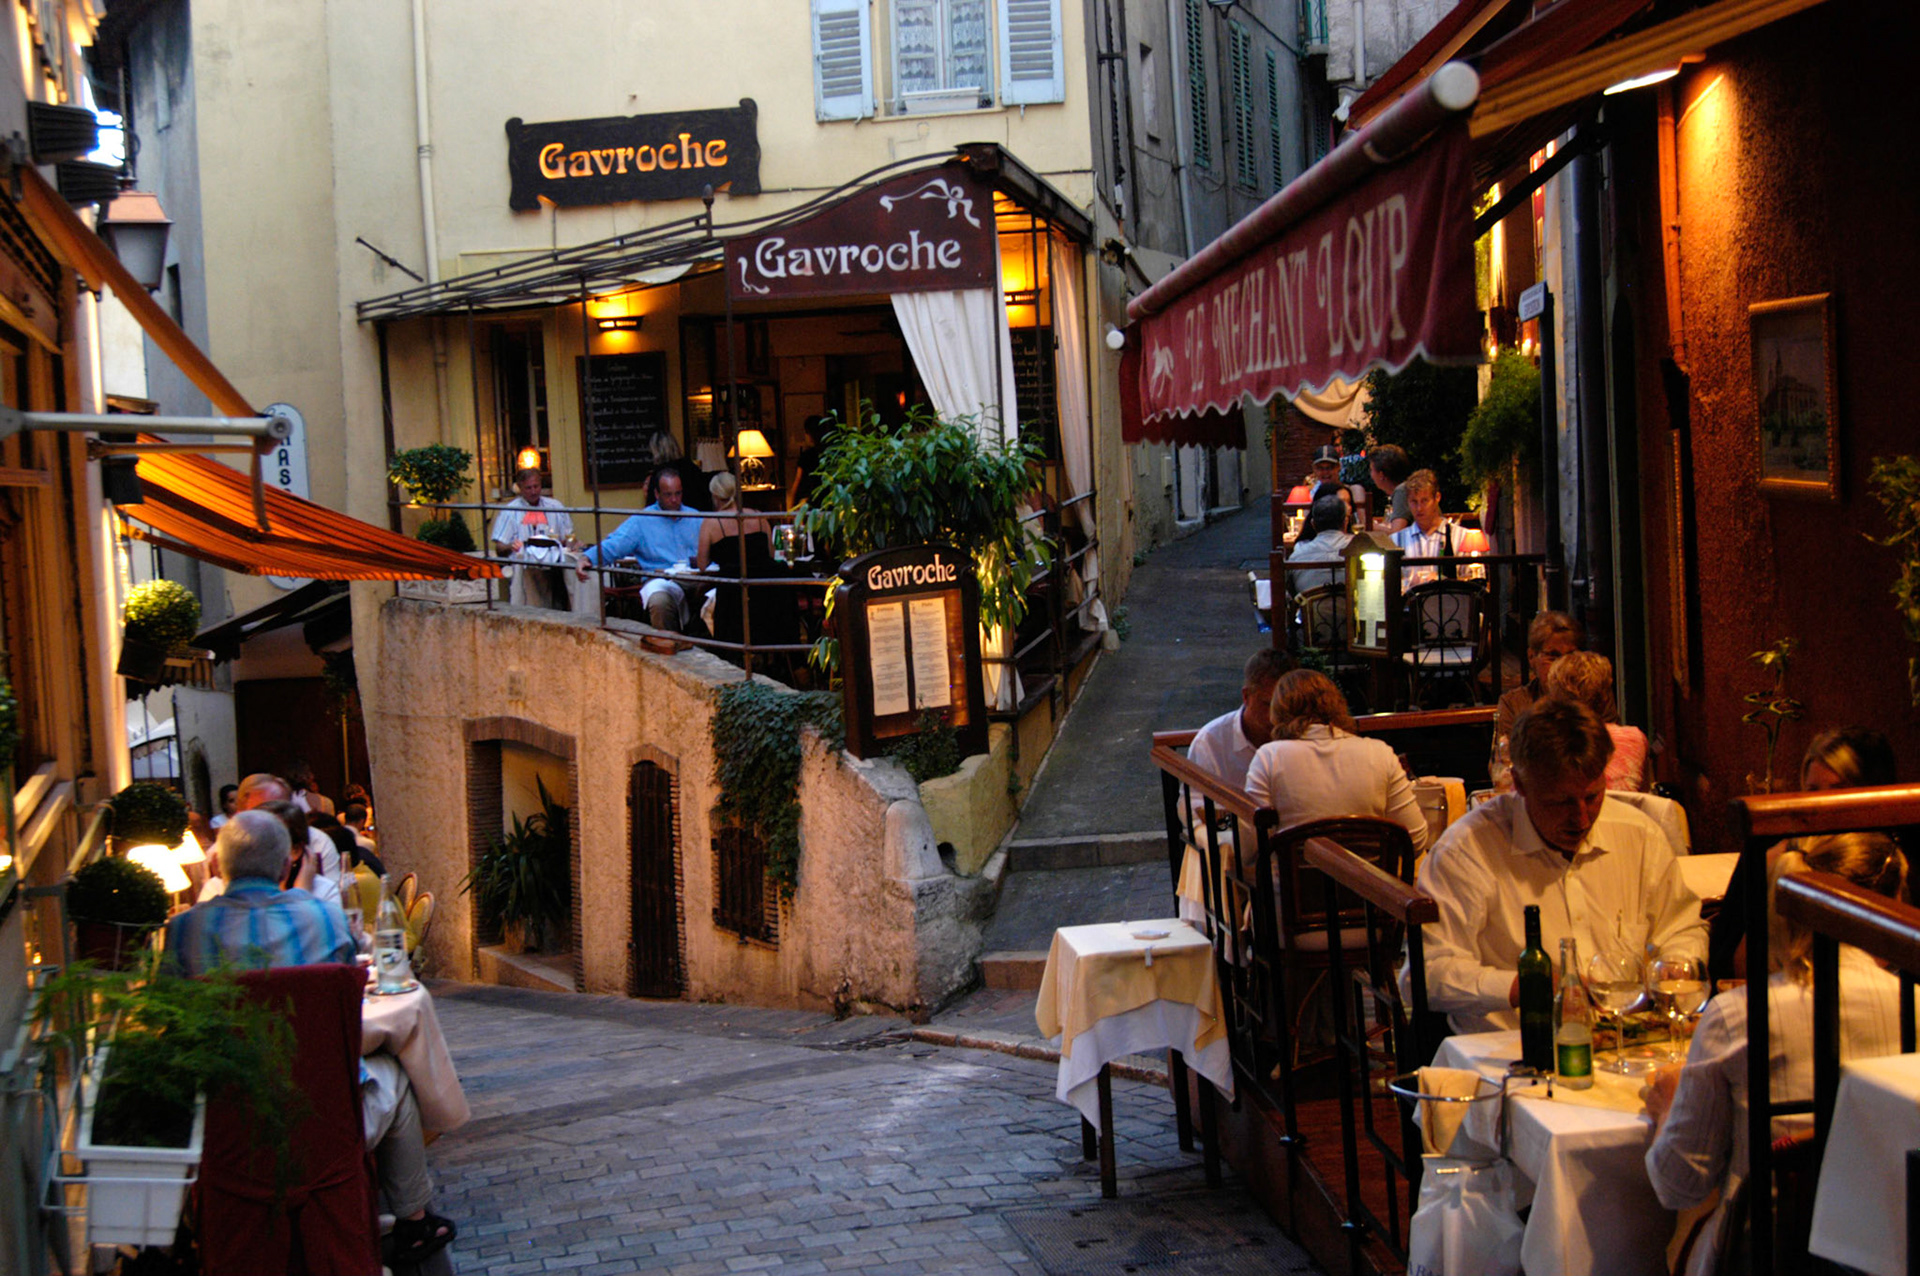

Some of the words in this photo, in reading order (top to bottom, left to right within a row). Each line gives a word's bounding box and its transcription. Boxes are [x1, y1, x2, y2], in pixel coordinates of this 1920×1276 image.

[539, 133, 728, 179] Gavroche
[755, 230, 962, 278] Gavroche
[1184, 303, 1205, 393] LE
[1212, 246, 1309, 385] MECHANT
[1316, 194, 1408, 357] LOUP
[867, 554, 957, 590] Gavroche
